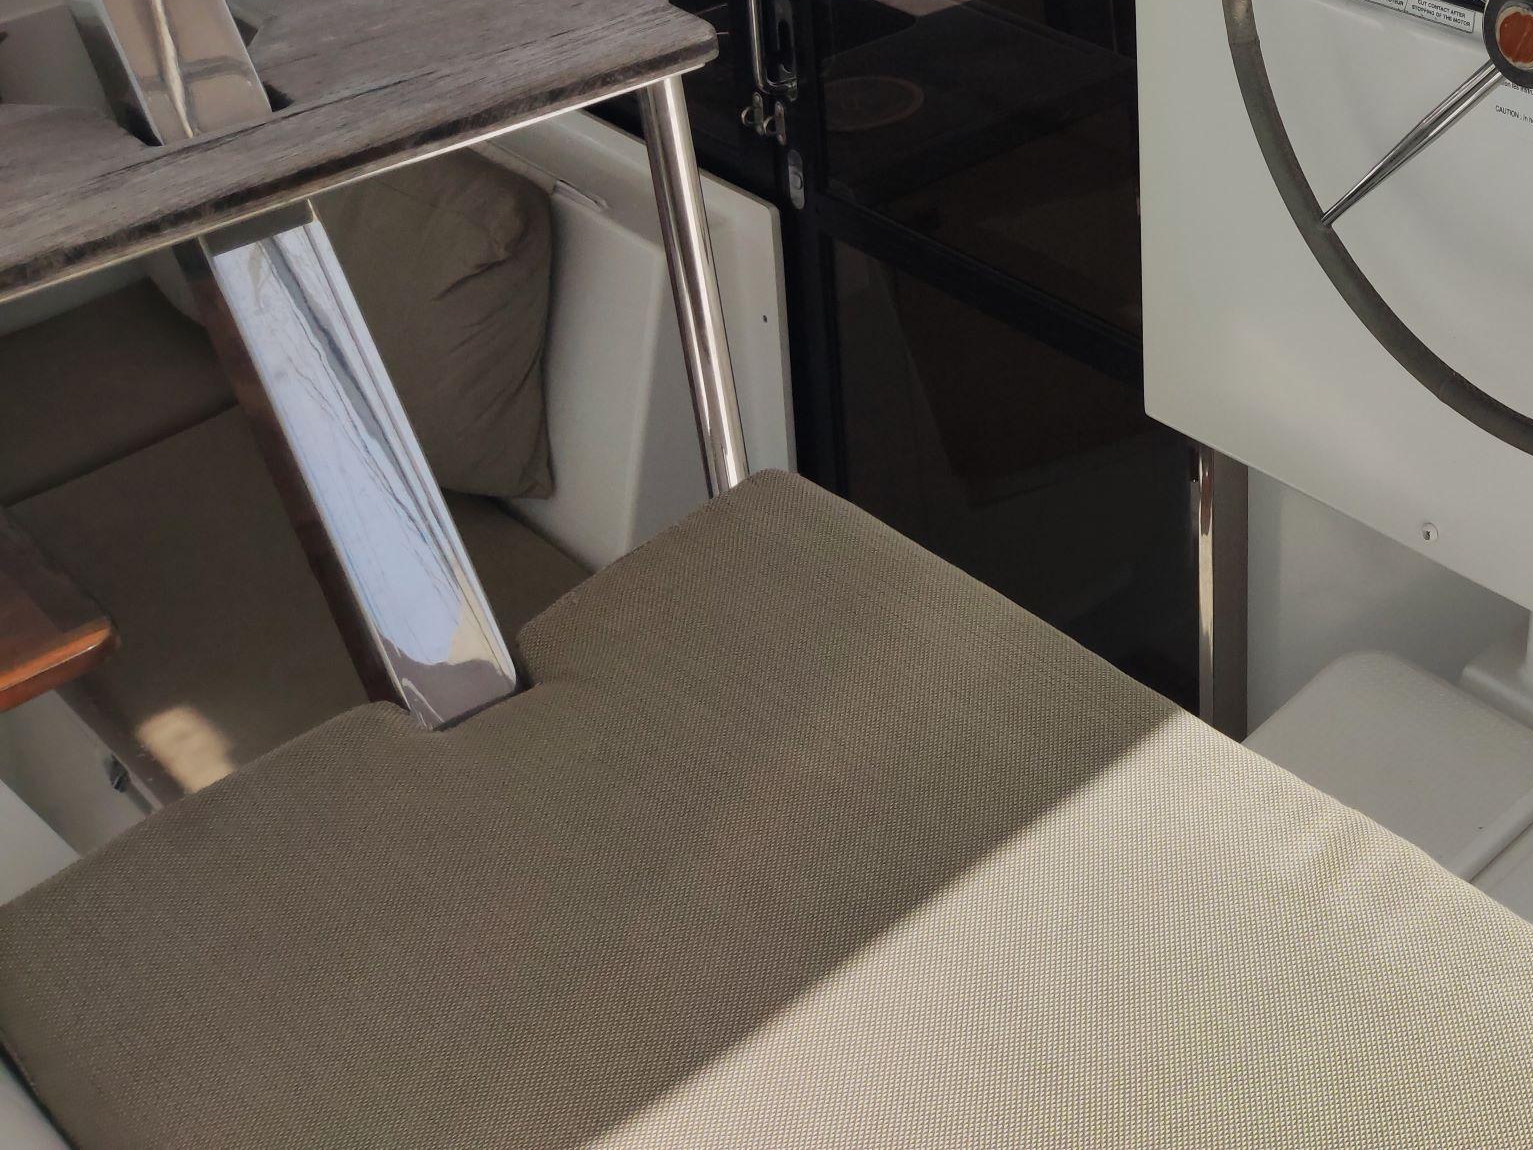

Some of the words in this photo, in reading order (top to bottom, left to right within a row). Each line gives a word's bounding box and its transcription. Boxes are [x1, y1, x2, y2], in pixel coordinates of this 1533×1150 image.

[1412, 4, 1434, 16] STOPPING
[1443, 14, 1452, 22] THE
[1453, 18, 1470, 27] MOTOR
[1428, 2, 1450, 13] CONTACT
[1450, 10, 1466, 18] AFTER
